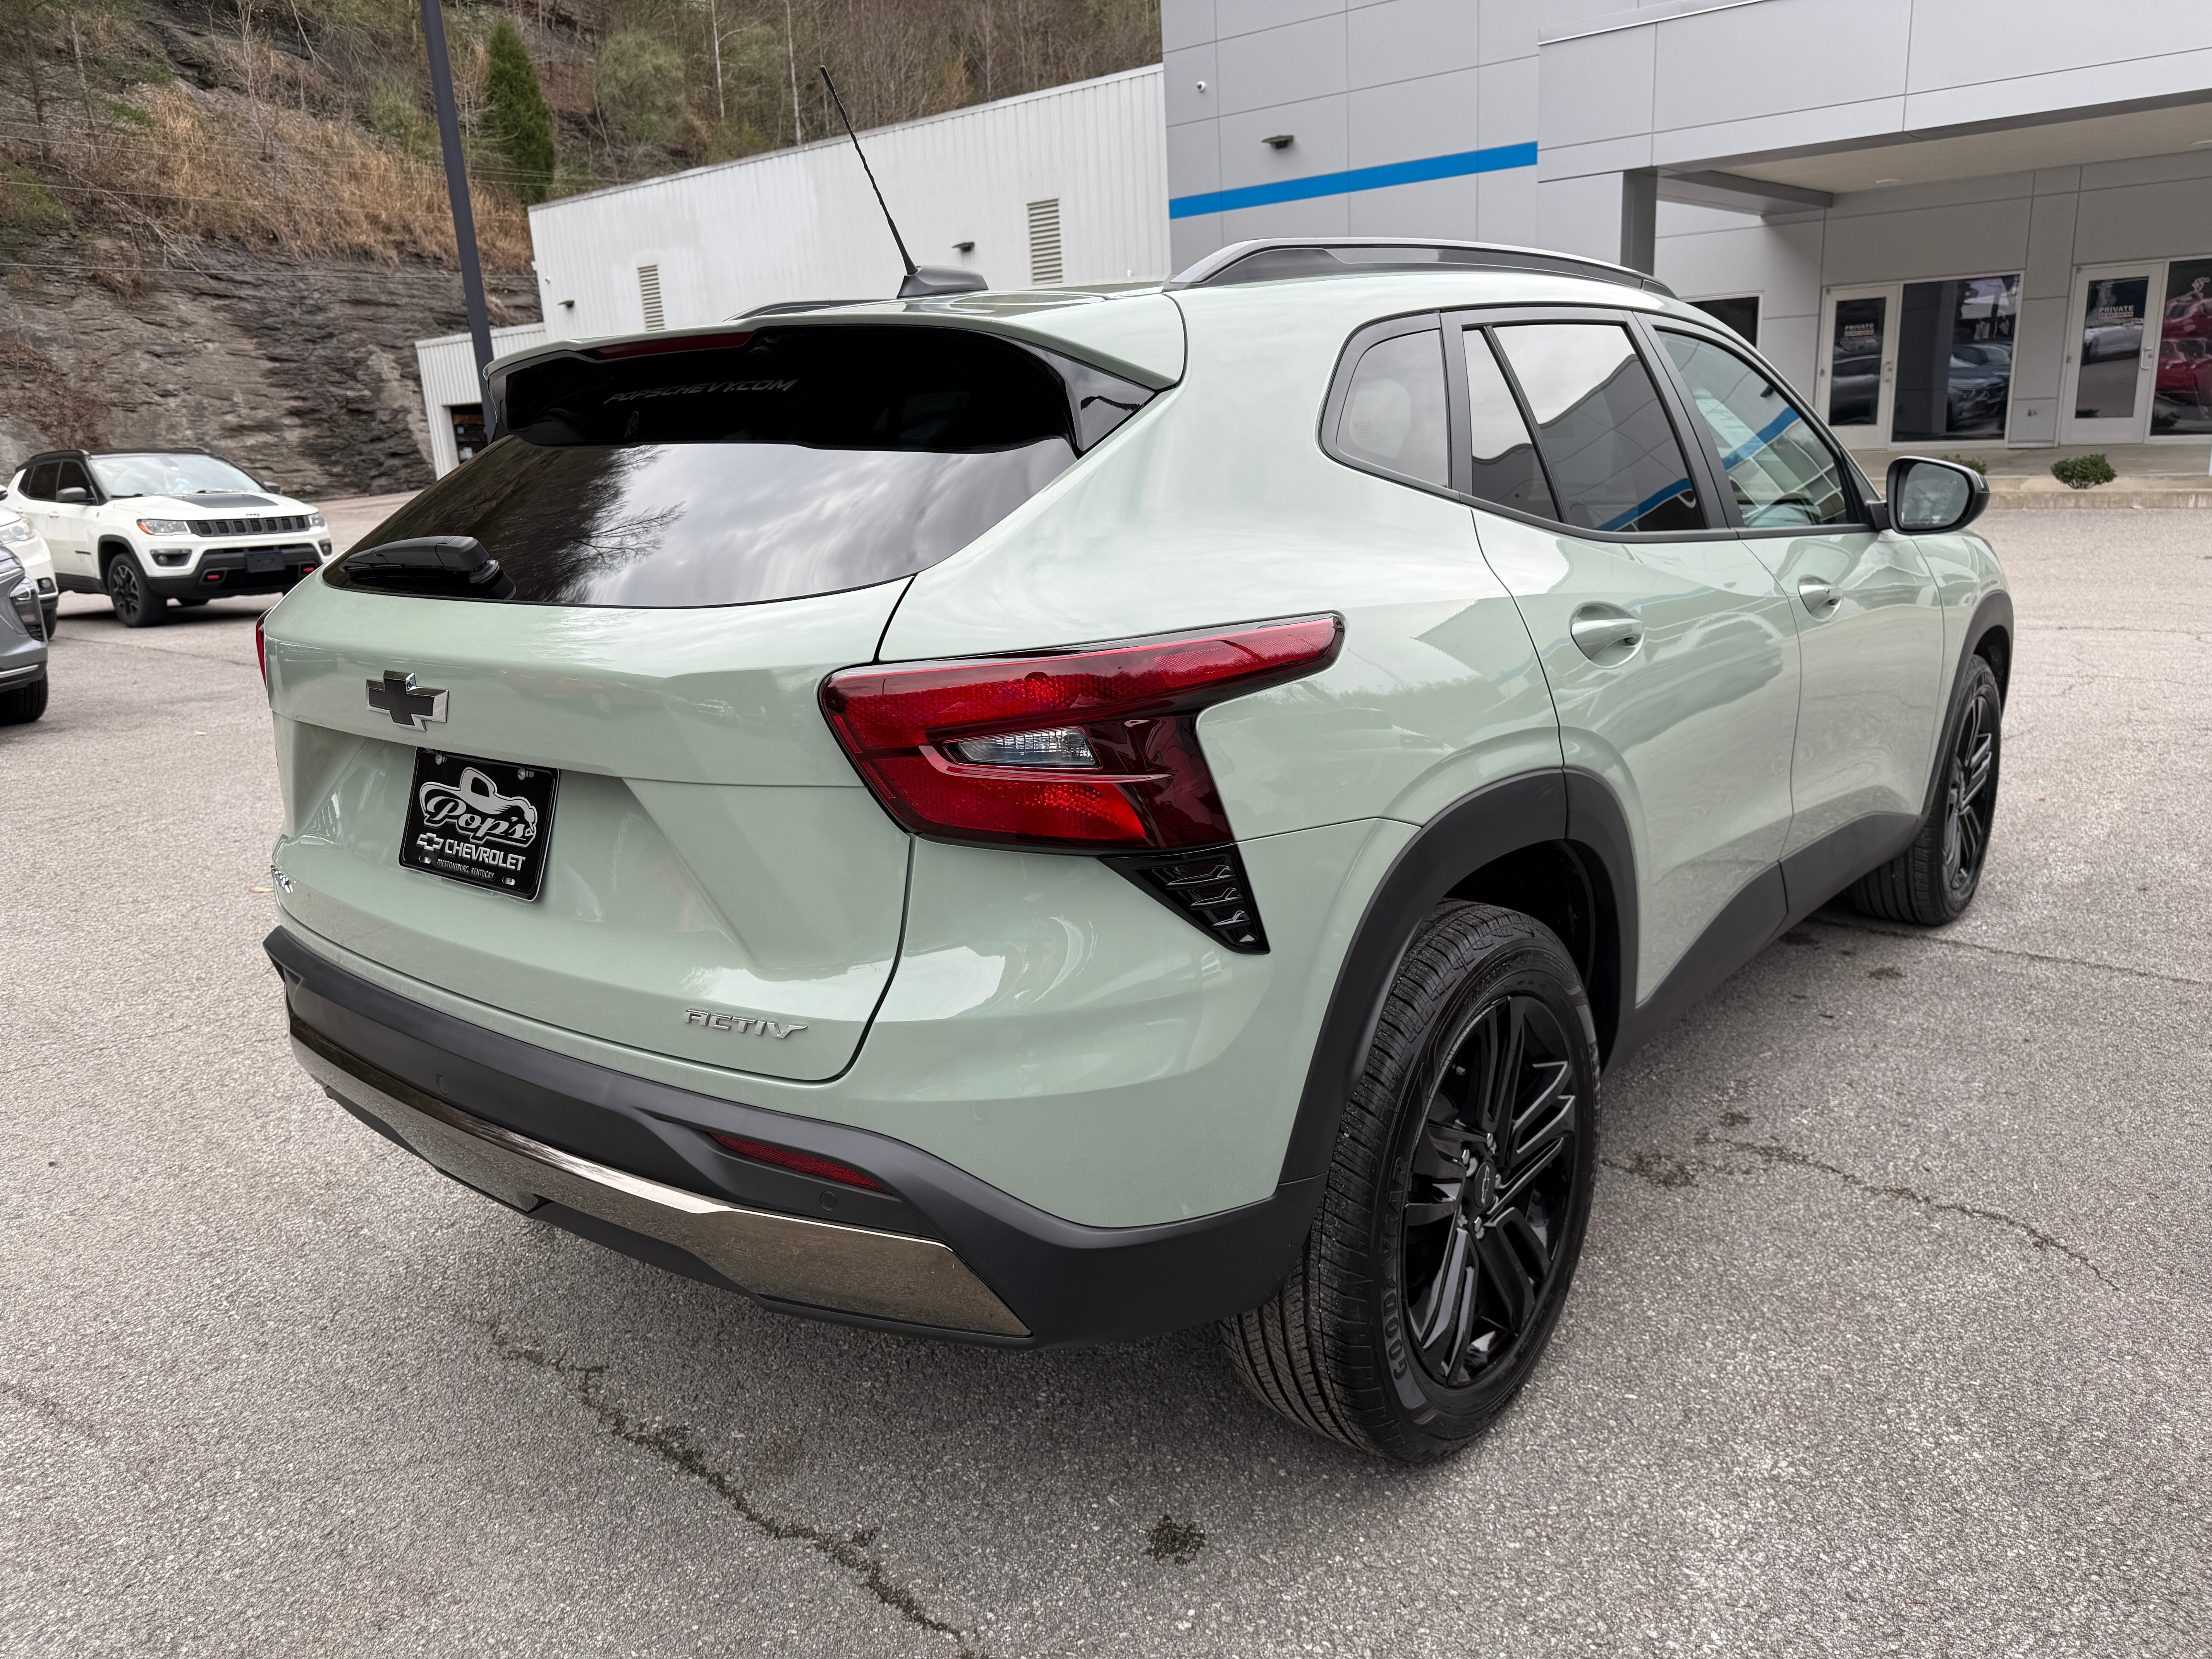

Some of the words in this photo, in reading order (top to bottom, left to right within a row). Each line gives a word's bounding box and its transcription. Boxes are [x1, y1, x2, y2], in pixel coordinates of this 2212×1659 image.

[2099, 305, 2134, 313] PRIVATE
[1844, 323, 1874, 331] PRIVATE
[603, 379, 799, 404] POPSCHEVY.COM
[427, 796, 527, 840] Pop's
[437, 859, 470, 874] PRESTONSBURG,
[471, 867, 495, 879] KENTUCKY
[444, 839, 526, 871] CHEVROLET
[684, 1008, 808, 1039] ACTIV
[1383, 1156, 1408, 1380] GOODYEAR
